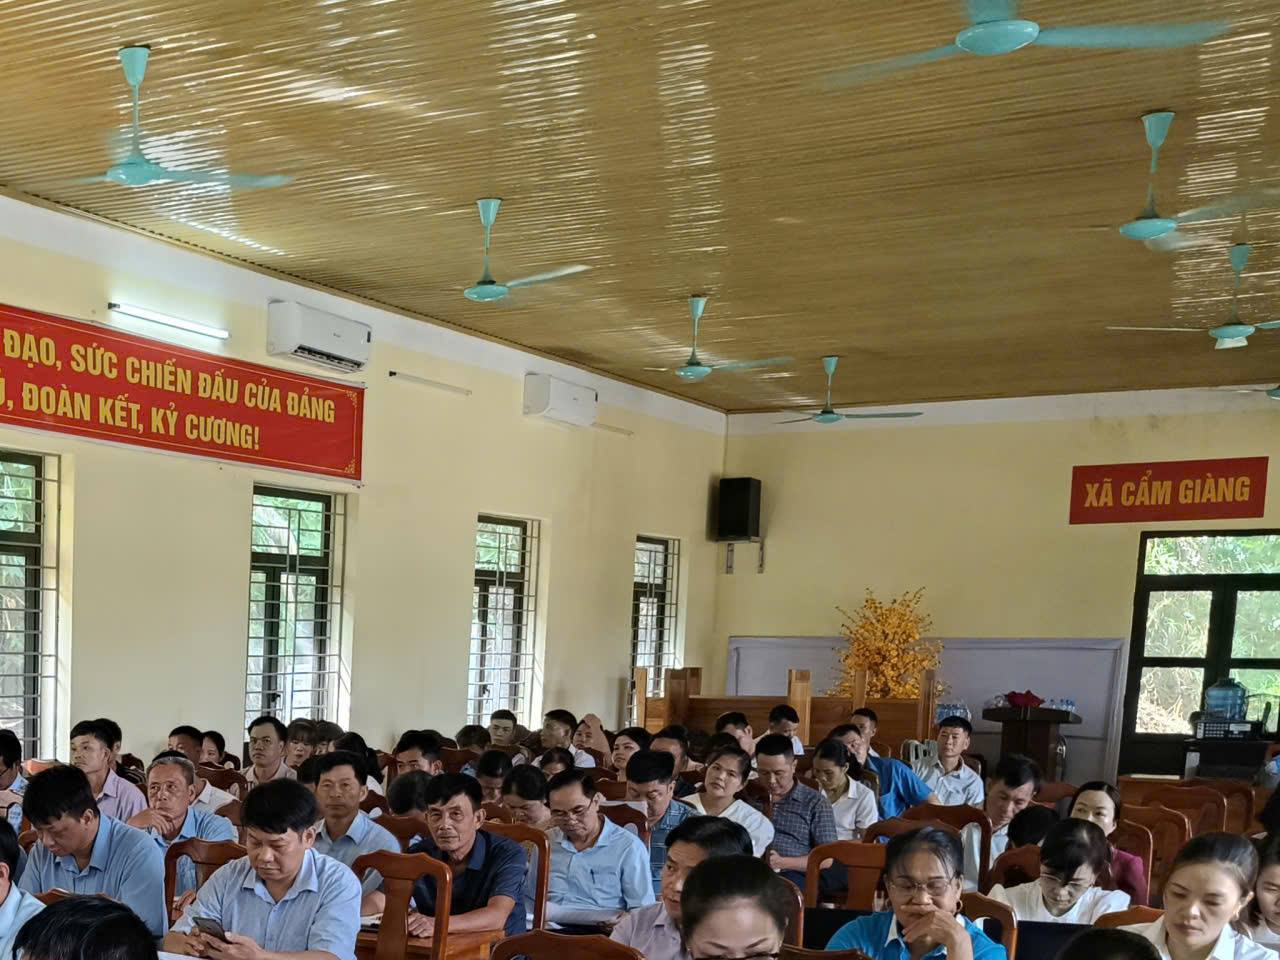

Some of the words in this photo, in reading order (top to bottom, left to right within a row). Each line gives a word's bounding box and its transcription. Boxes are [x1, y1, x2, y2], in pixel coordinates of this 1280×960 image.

[2, 328, 61, 371] ĐẠO,
[70, 342, 118, 379] SỨC
[126, 356, 191, 395] CHIẾN
[198, 369, 238, 404] ĐẤU
[244, 378, 281, 413] CỦA
[286, 387, 335, 423] ĐẢNG
[22, 383, 91, 421] ĐOÀN
[99, 396, 144, 434] KẾT,
[152, 402, 176, 435] KỶ
[185, 413, 260, 451] CƯƠNG!
[1084, 478, 1113, 507] XÃ
[1121, 470, 1172, 506] CẨM
[1179, 473, 1251, 505] GIÀNG
